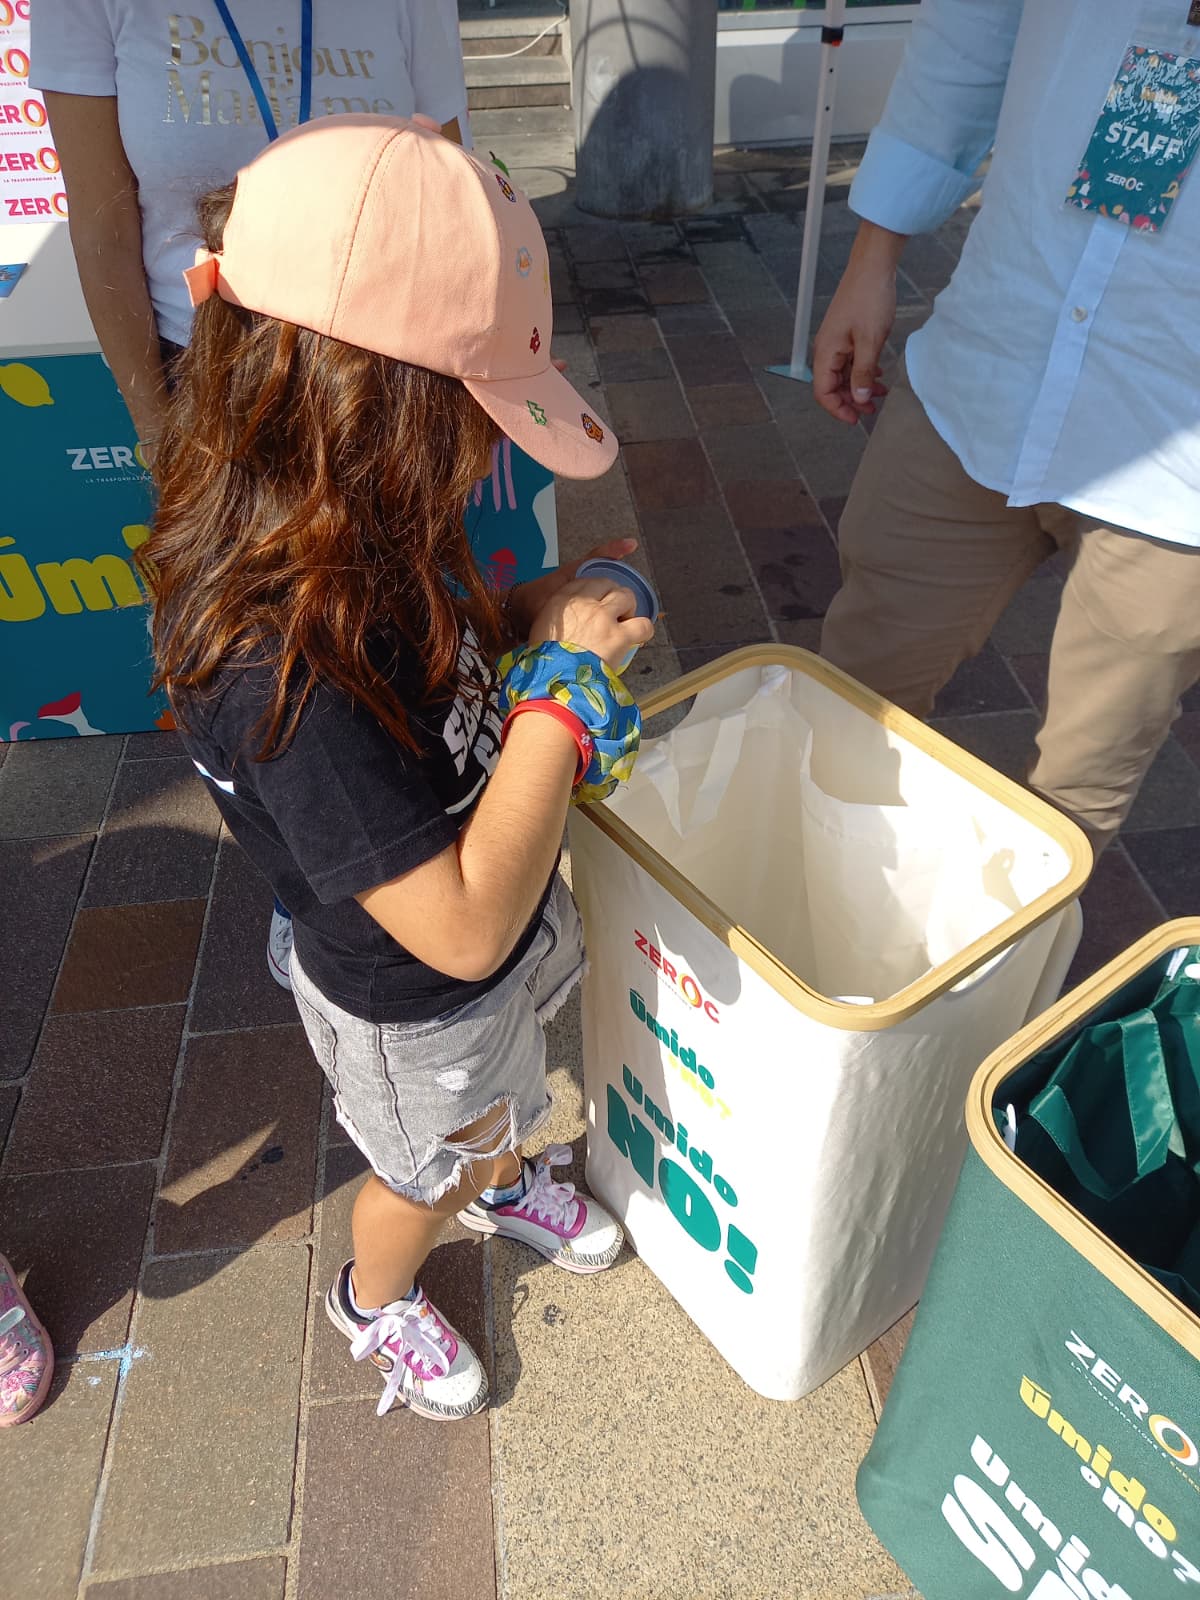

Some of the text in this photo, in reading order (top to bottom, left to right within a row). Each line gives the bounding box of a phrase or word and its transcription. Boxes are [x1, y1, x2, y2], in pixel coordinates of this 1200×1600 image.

[165, 14, 375, 93] Bonjour
[1105, 122, 1184, 159] STAFF
[1105, 172, 1145, 191] ZEROC
[634, 929, 720, 1024] ZEROC
[607, 1083, 758, 1295] NO!
